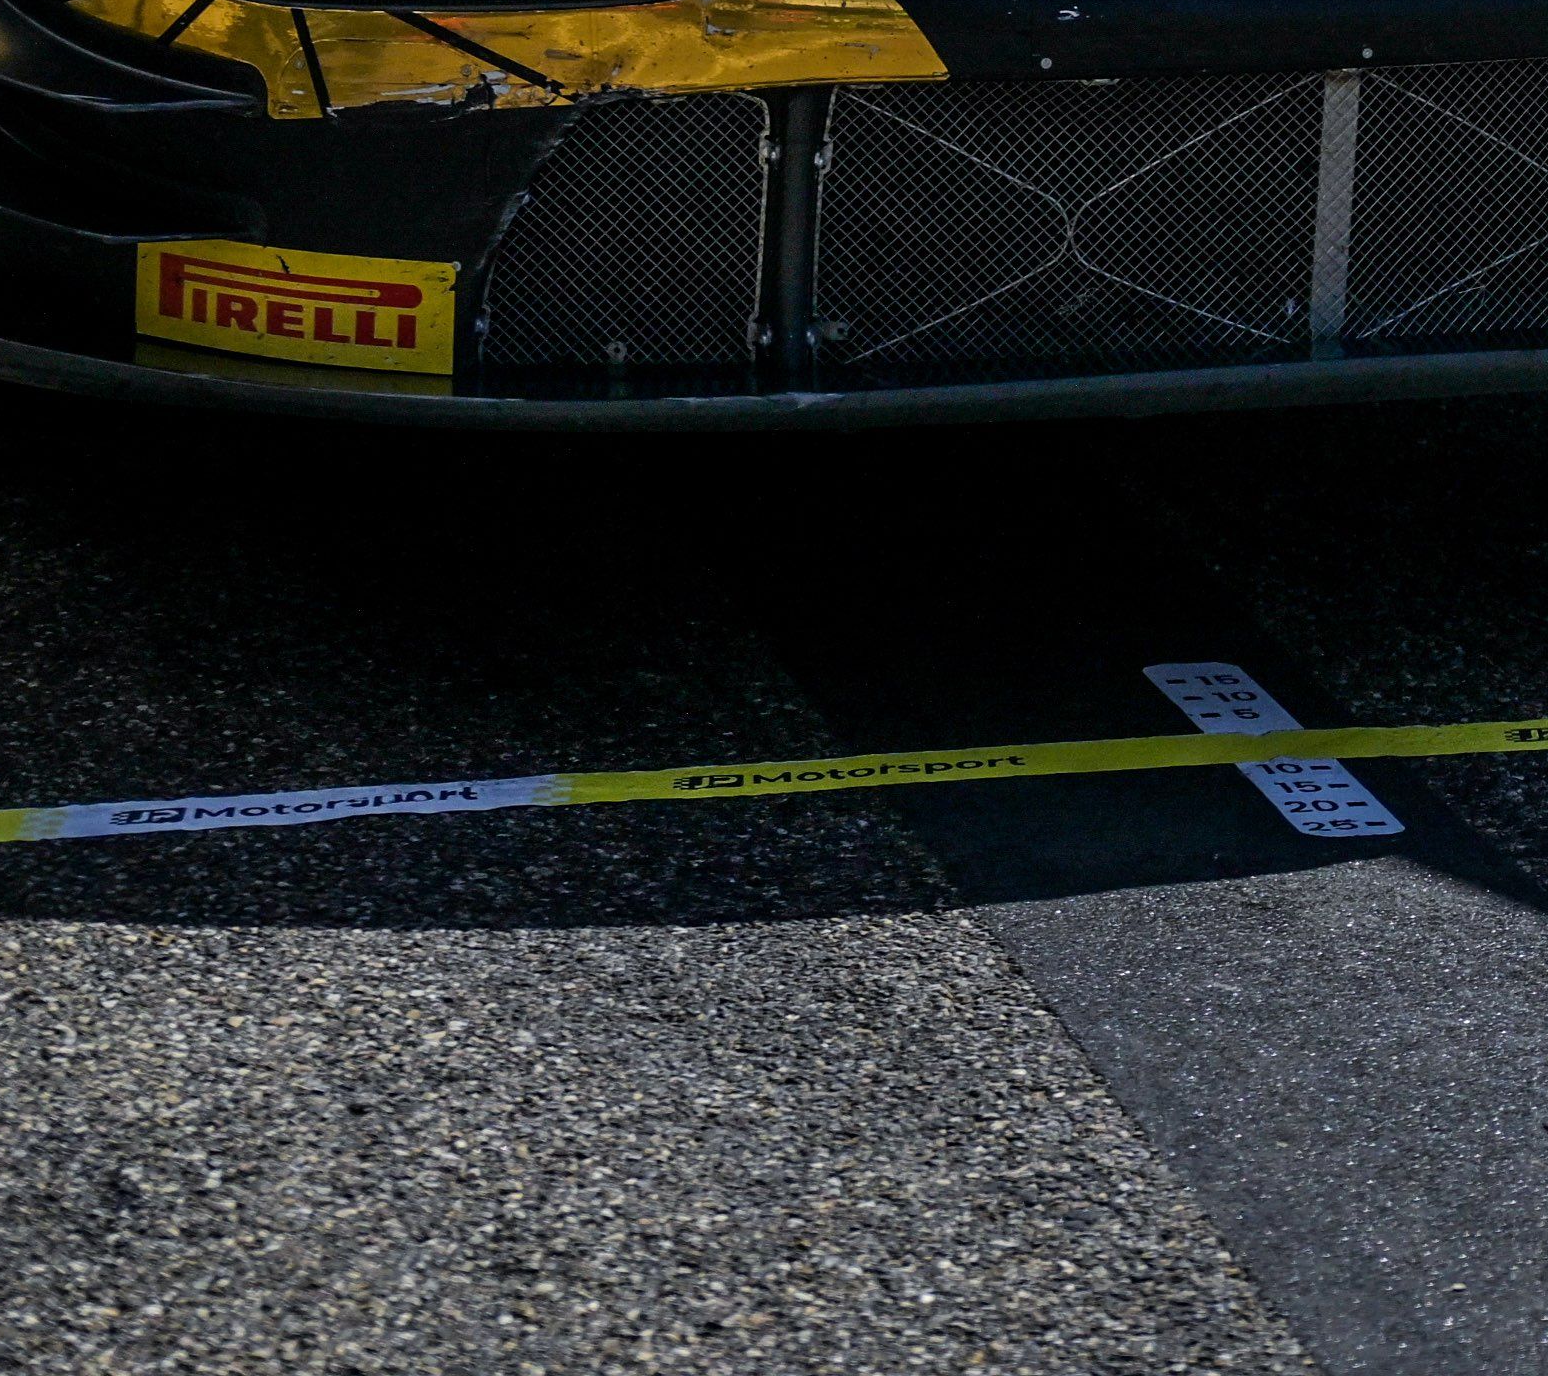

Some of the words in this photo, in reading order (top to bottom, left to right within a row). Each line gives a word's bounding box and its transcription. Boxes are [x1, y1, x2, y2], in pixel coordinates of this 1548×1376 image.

[158, 252, 423, 349] PIRELLI
[1194, 674, 1240, 685] 15
[1211, 691, 1257, 702] 10
[1231, 709, 1260, 720] 5
[753, 754, 1027, 786] Motorsport
[1256, 763, 1304, 775] 10
[1274, 781, 1323, 793] 15
[194, 785, 479, 820] Motorsport
[1284, 800, 1340, 813] 20
[1302, 819, 1359, 832] 25
